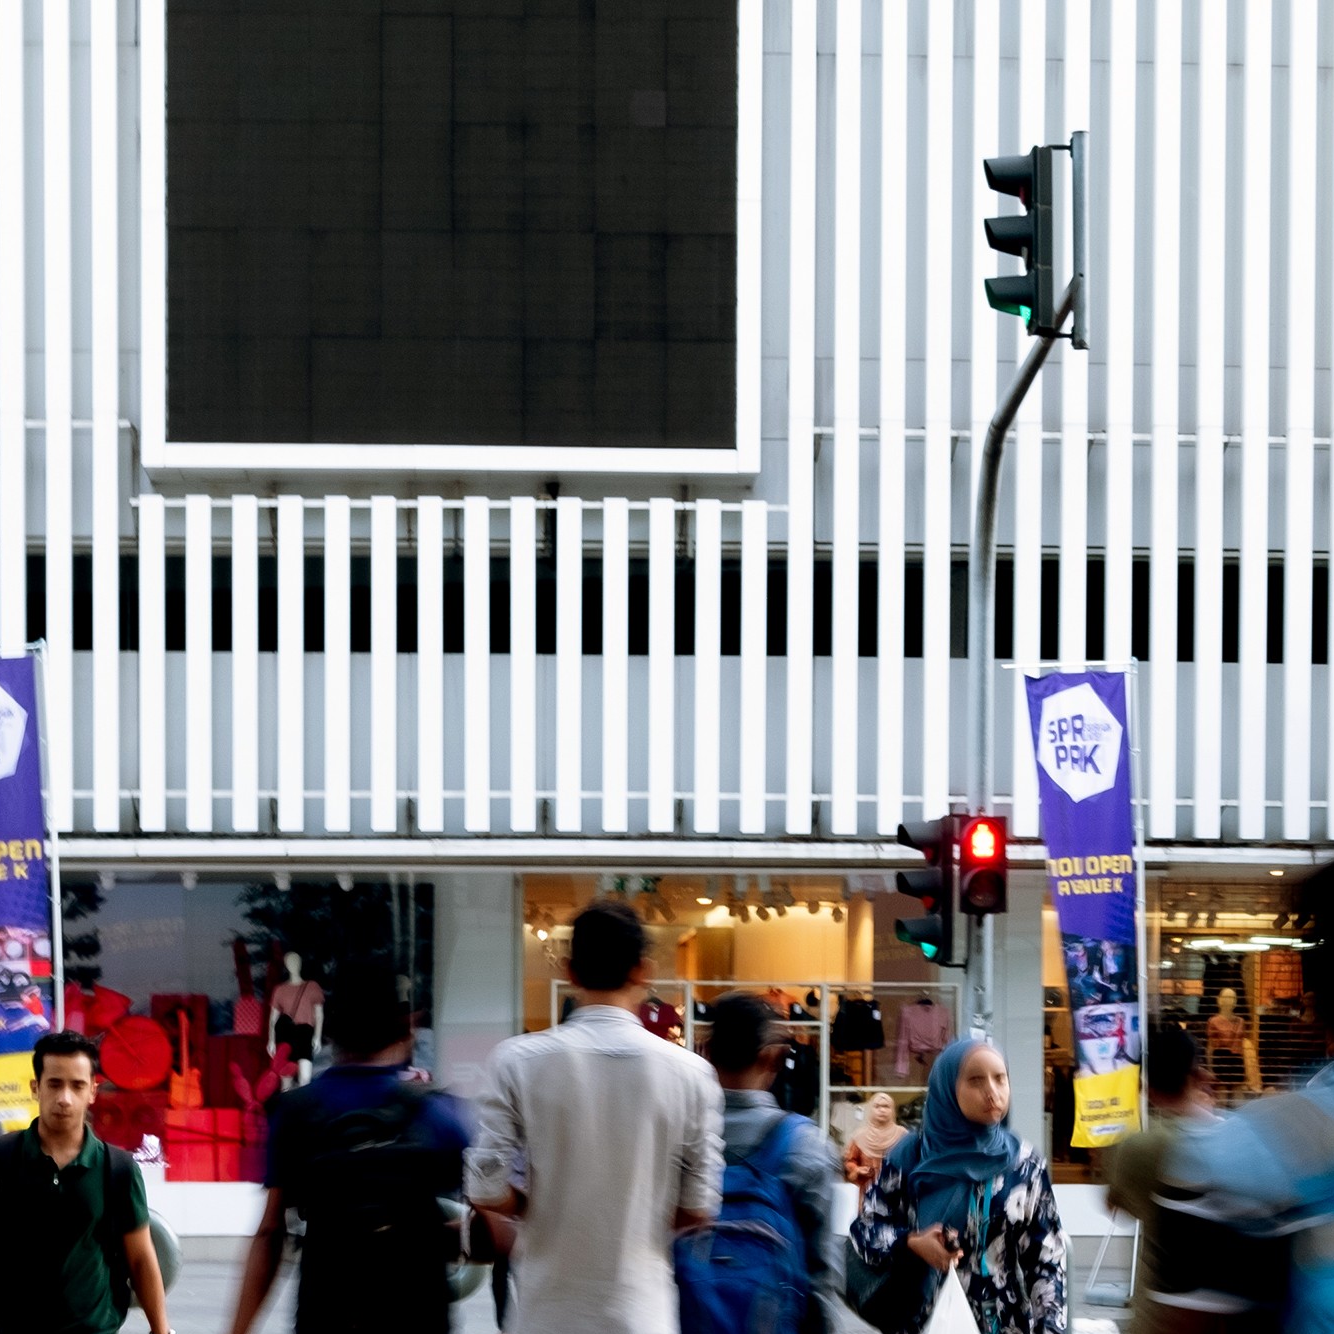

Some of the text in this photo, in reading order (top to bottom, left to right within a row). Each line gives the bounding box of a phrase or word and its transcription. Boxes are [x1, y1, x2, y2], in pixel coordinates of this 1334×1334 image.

[1048, 714, 1084, 743] SPR
[1055, 744, 1101, 774] PRK
[13, 862, 28, 880] K
